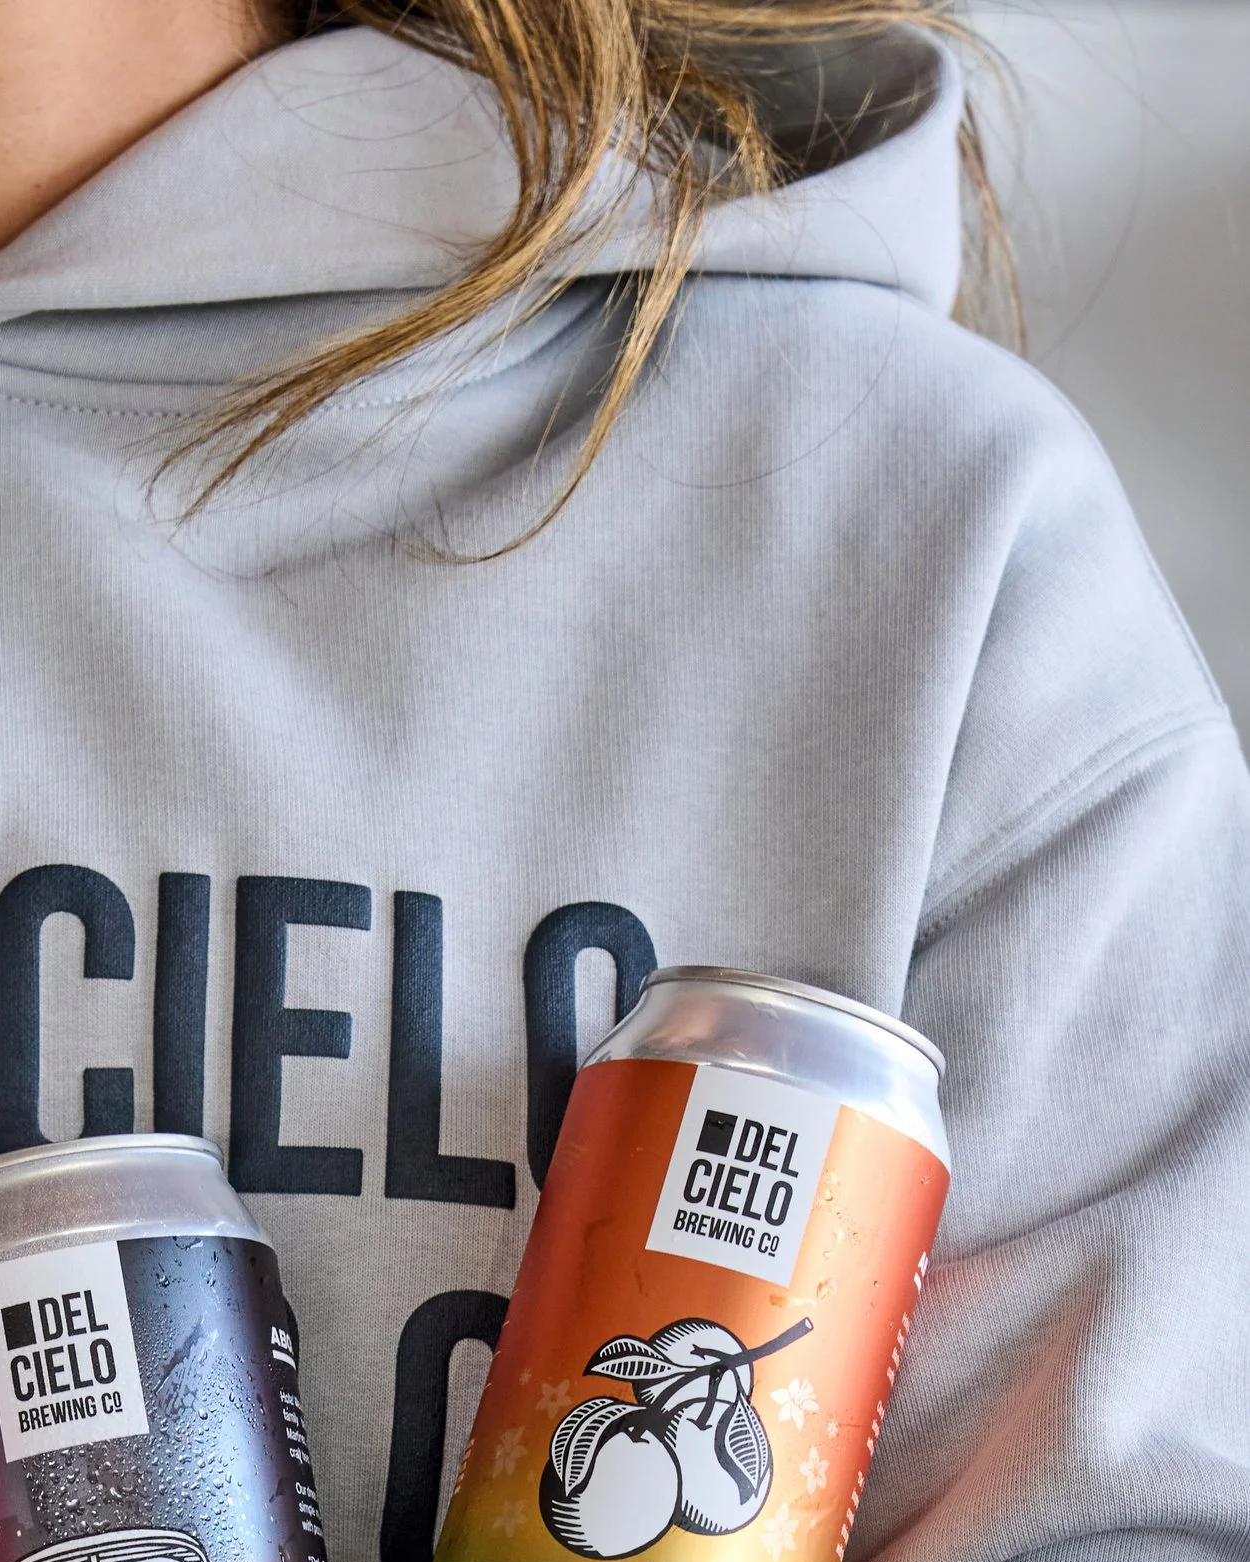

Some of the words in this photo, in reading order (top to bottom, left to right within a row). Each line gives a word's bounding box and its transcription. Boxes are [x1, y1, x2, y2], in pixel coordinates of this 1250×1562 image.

[734, 1119, 799, 1178] DEL
[683, 1158, 794, 1227] CIELO
[673, 1209, 756, 1249] BREWING
[37, 1289, 109, 1342] DEL
[271, 1325, 294, 1356] ABO
[10, 1338, 117, 1402] CIELO
[18, 1395, 97, 1433] BREWING
